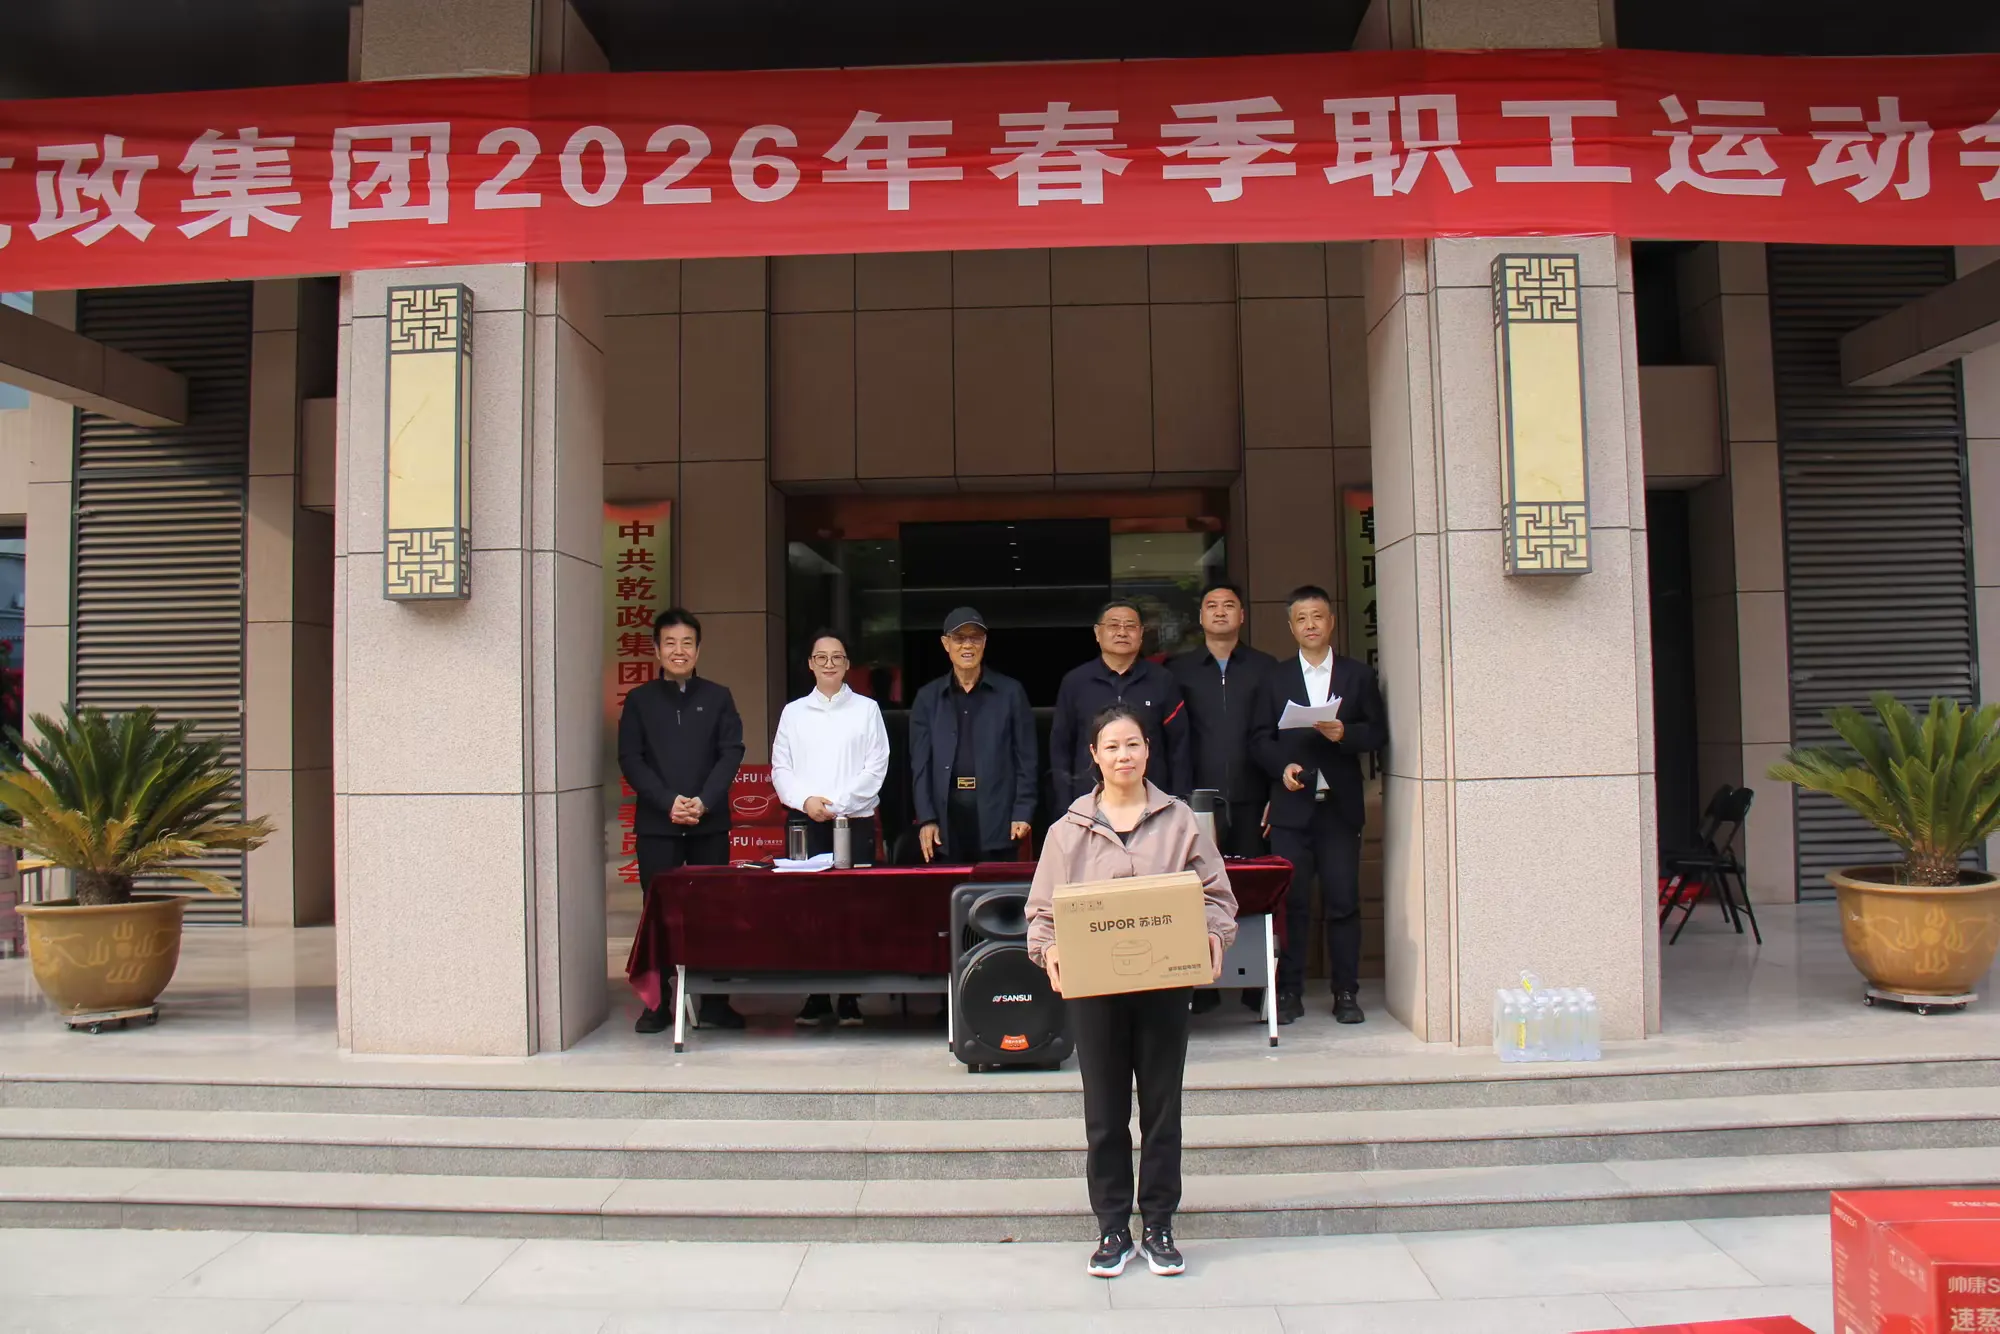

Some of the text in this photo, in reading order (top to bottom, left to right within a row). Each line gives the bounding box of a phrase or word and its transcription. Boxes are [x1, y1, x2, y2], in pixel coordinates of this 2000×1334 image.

[0, 94, 2000, 249] 政集团2026年春季职工运动
[1089, 914, 1173, 933] SUPOR 苏泊尔
[1002, 994, 1032, 1003] SANSUI
